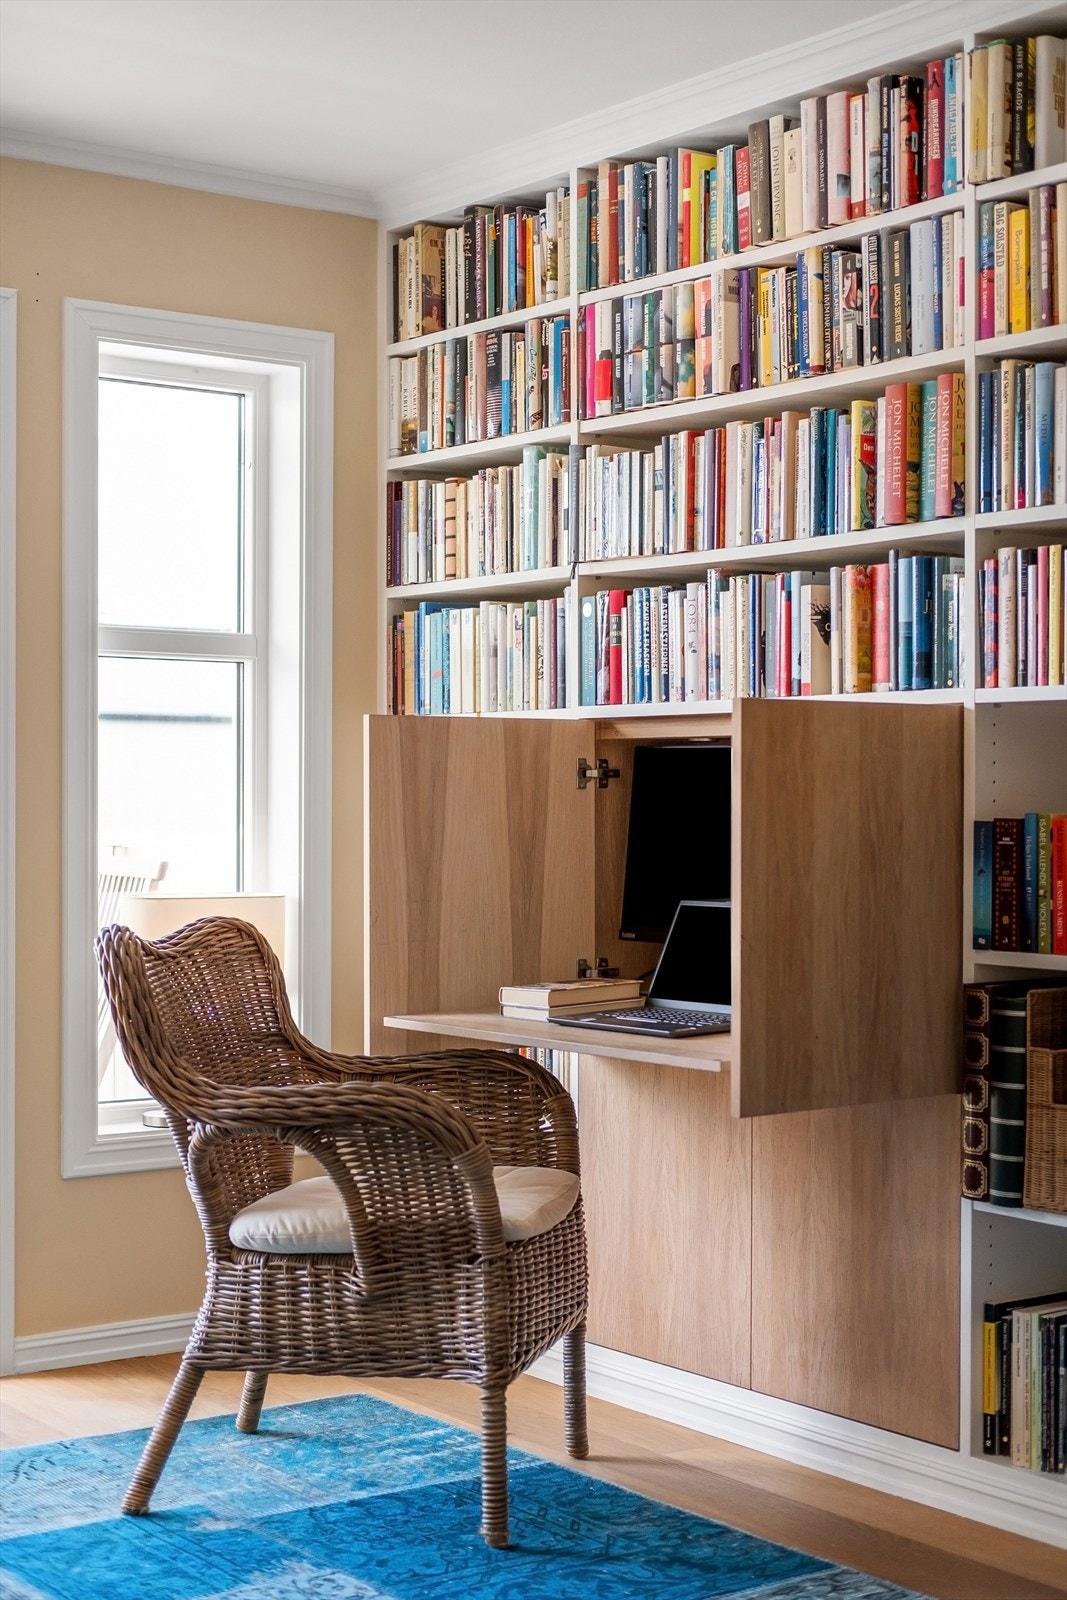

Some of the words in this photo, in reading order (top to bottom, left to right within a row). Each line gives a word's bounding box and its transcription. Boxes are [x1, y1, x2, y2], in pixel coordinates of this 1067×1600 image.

[931, 98, 940, 160] HUNDREÅRINGEN
[948, 93, 957, 158] ANALFABETEN
[772, 146, 780, 177] JOHN
[773, 180, 781, 222] IRVING
[996, 207, 1005, 226] DAG
[464, 231, 472, 258] 1814
[869, 235, 878, 251] VETLE
[869, 252, 878, 261] LID
[996, 228, 1005, 268] SOLSTAD
[1013, 230, 1023, 285] Barnepiken
[869, 261, 879, 284] LARSSEN
[870, 285, 878, 318] 2
[542, 364, 549, 380] Ja
[892, 399, 901, 425] JON
[928, 396, 936, 422] JON
[940, 390, 950, 416] JON
[863, 443, 874, 452] Den
[928, 426, 936, 496] MICHELET
[940, 420, 949, 490] MICHELET
[892, 429, 901, 498] MICHELET
